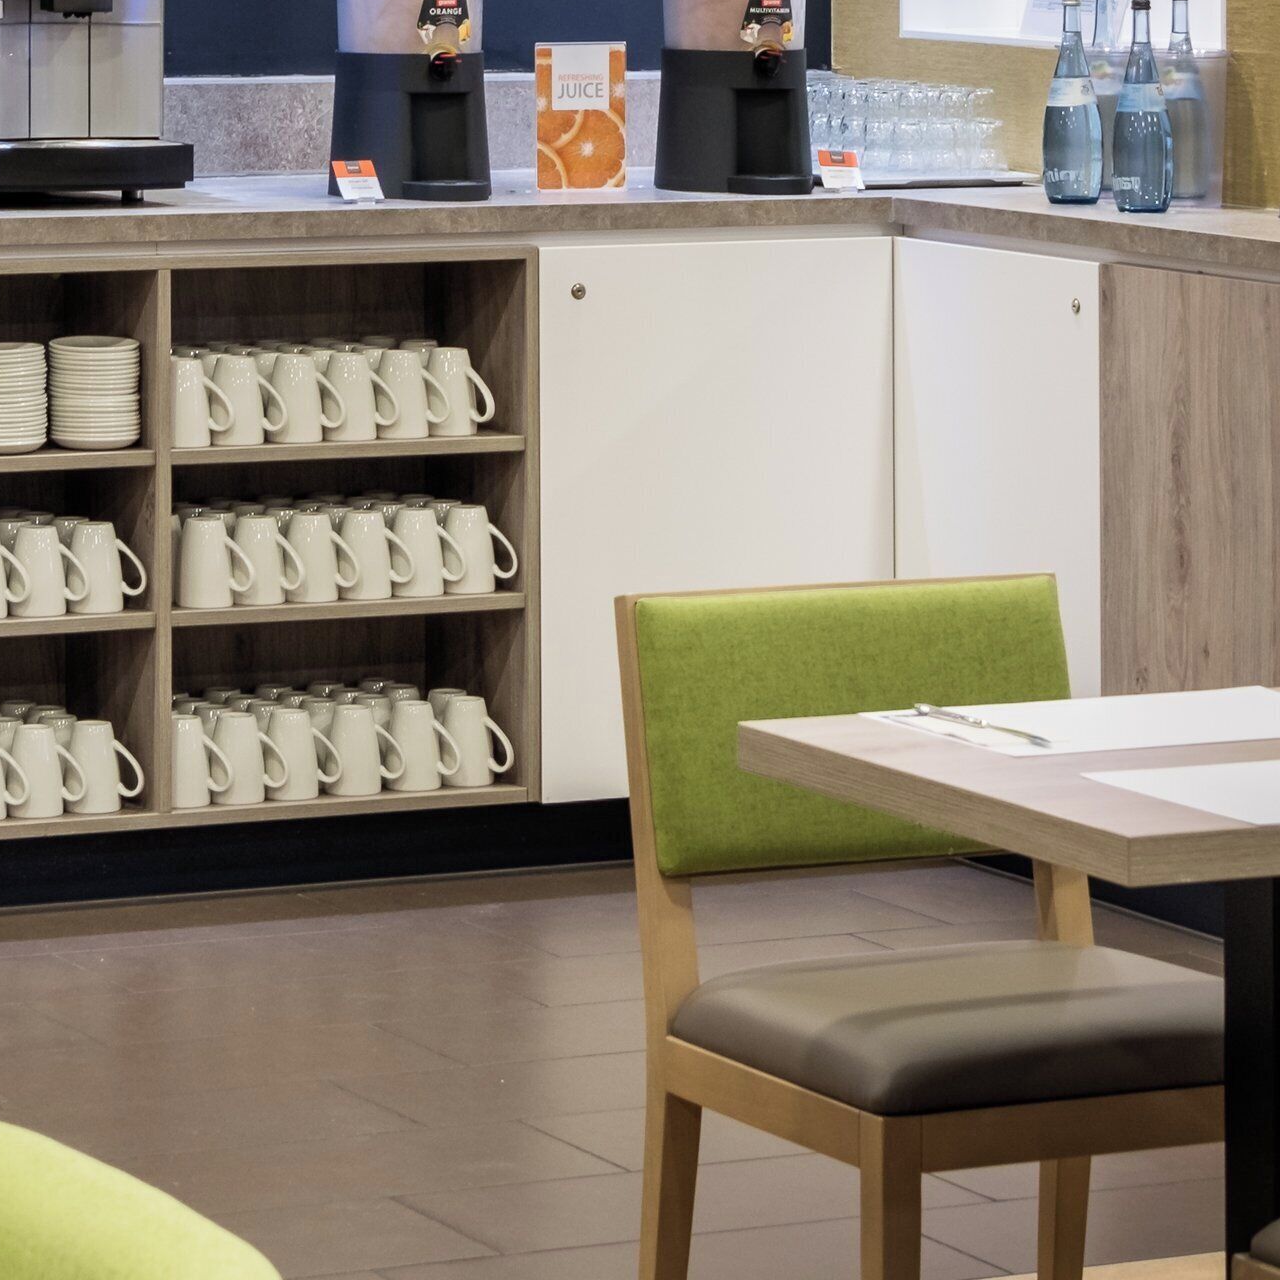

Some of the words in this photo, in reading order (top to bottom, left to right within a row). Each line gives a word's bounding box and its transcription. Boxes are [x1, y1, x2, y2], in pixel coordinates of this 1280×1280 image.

[429, 7, 463, 16] ORANGE
[558, 73, 604, 82] REFRESHING
[557, 82, 605, 99] JUICE
